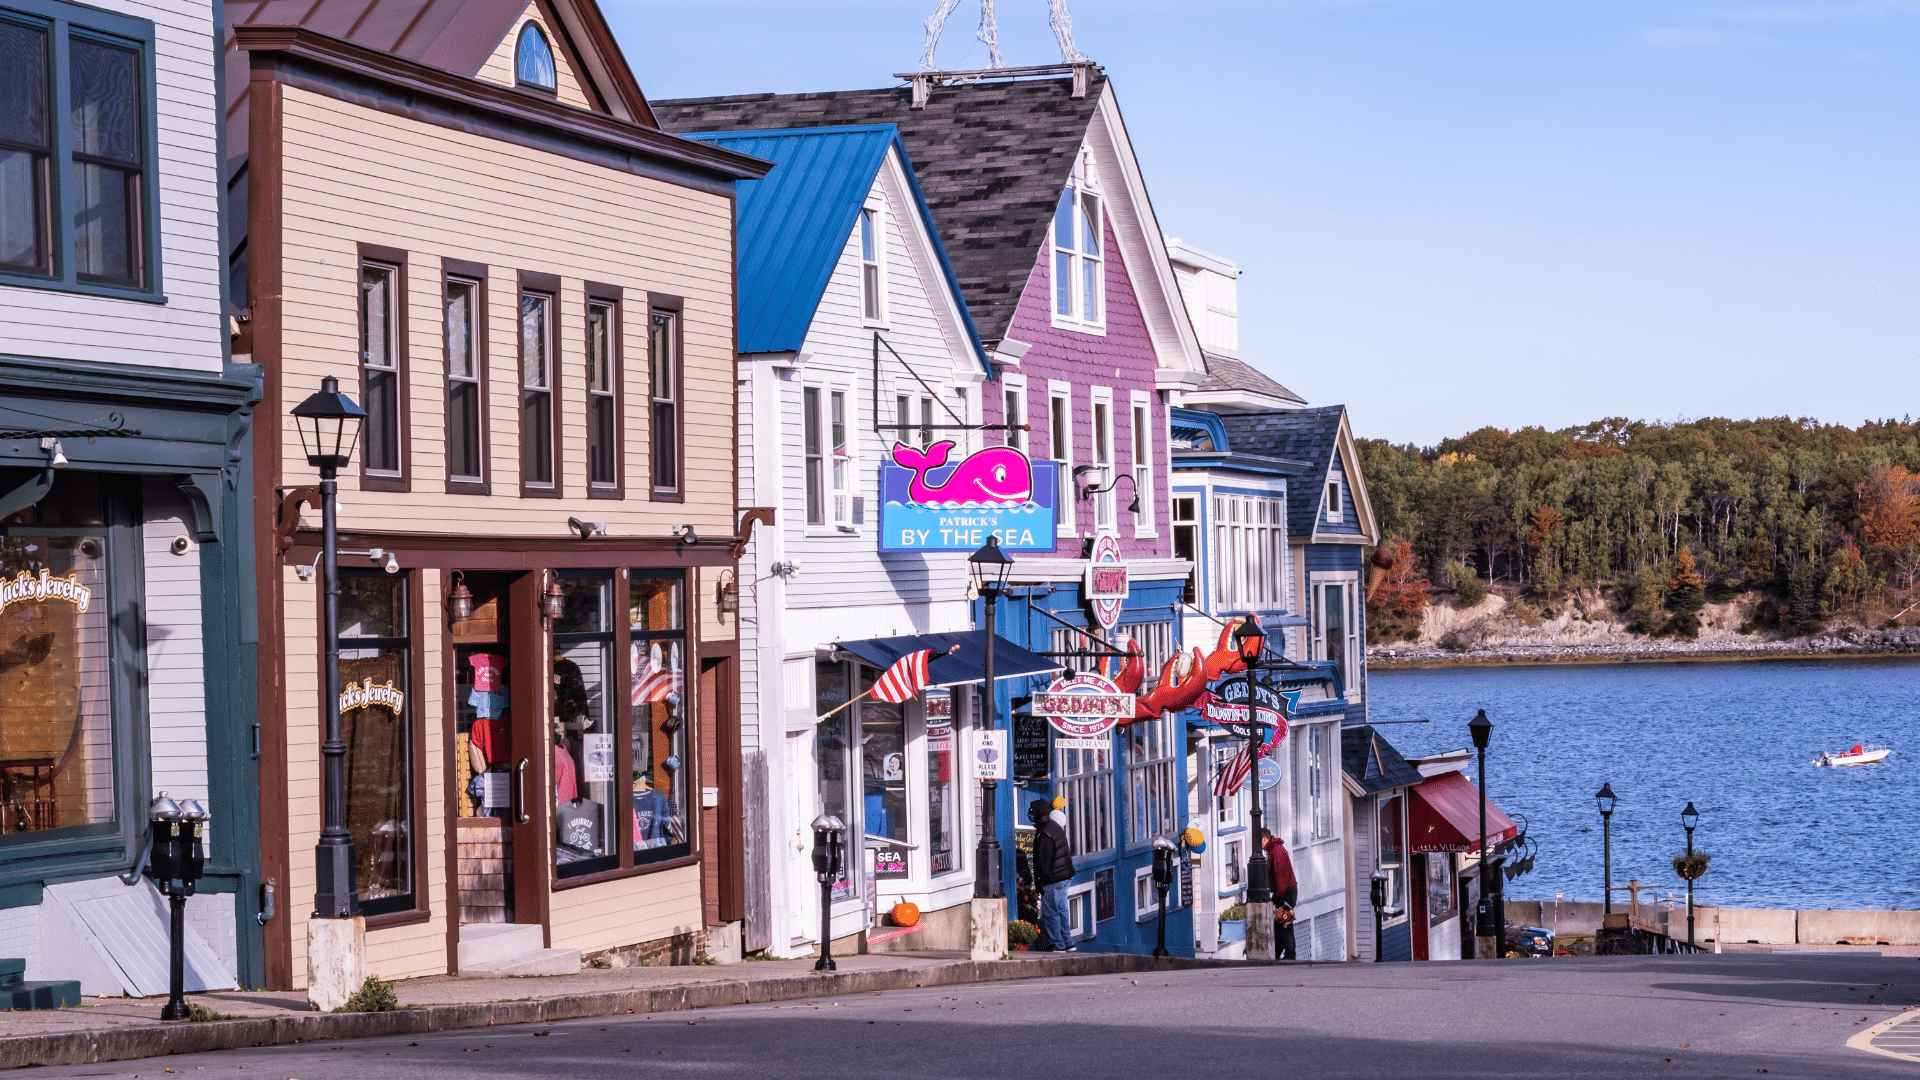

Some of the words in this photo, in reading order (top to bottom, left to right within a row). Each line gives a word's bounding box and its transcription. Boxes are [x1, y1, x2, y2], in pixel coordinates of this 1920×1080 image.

[939, 517, 998, 527] PATRICK'S
[901, 529, 931, 546] BY
[939, 529, 983, 546] THE
[991, 529, 1035, 546] SEA
[36, 569, 90, 612] Jewelry
[1060, 676, 1081, 688] MEET
[361, 678, 403, 714] Jewelry
[1206, 703, 1279, 727] DOWN-UDER
[1061, 722, 1085, 733] SINCE
[1088, 722, 1105, 733] 1974
[1232, 724, 1247, 735] COOL
[1056, 740, 1109, 748] RESTAURANT
[877, 852, 902, 862] SEA
